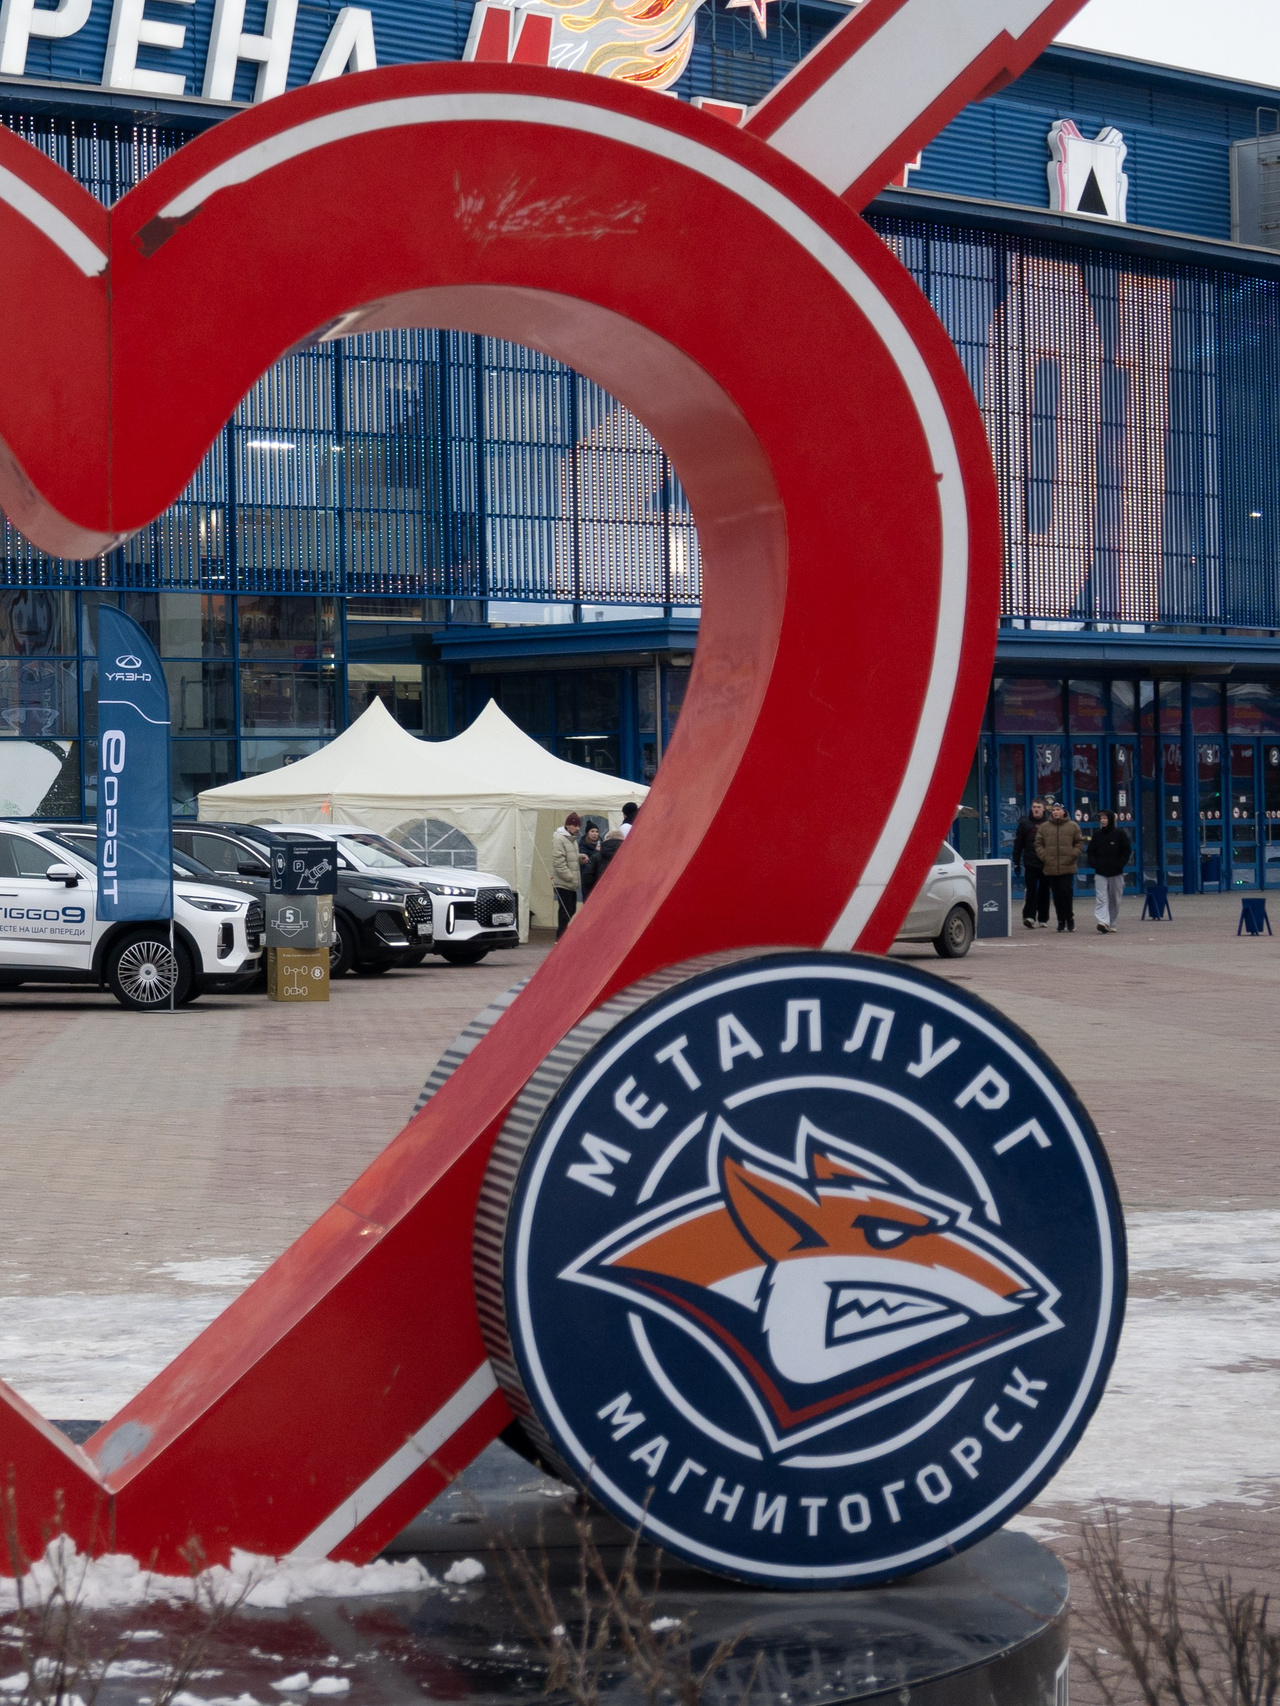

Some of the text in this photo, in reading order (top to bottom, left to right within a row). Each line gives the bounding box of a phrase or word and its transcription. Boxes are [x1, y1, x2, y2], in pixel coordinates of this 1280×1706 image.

[1045, 750, 1053, 763] 5
[1118, 750, 1125, 763] 4
[1206, 750, 1213, 763] 3
[1271, 750, 1278, 763] 2
[285, 909, 295, 922] 5
[19, 926, 31, 934] НА
[49, 928, 86, 936] ВПЕРЕДИ
[314, 968, 321, 977] 8
[566, 998, 1052, 1197] МЕТАЛЛУРГ
[596, 1367, 1048, 1536] МАГНИТОГОРСК
